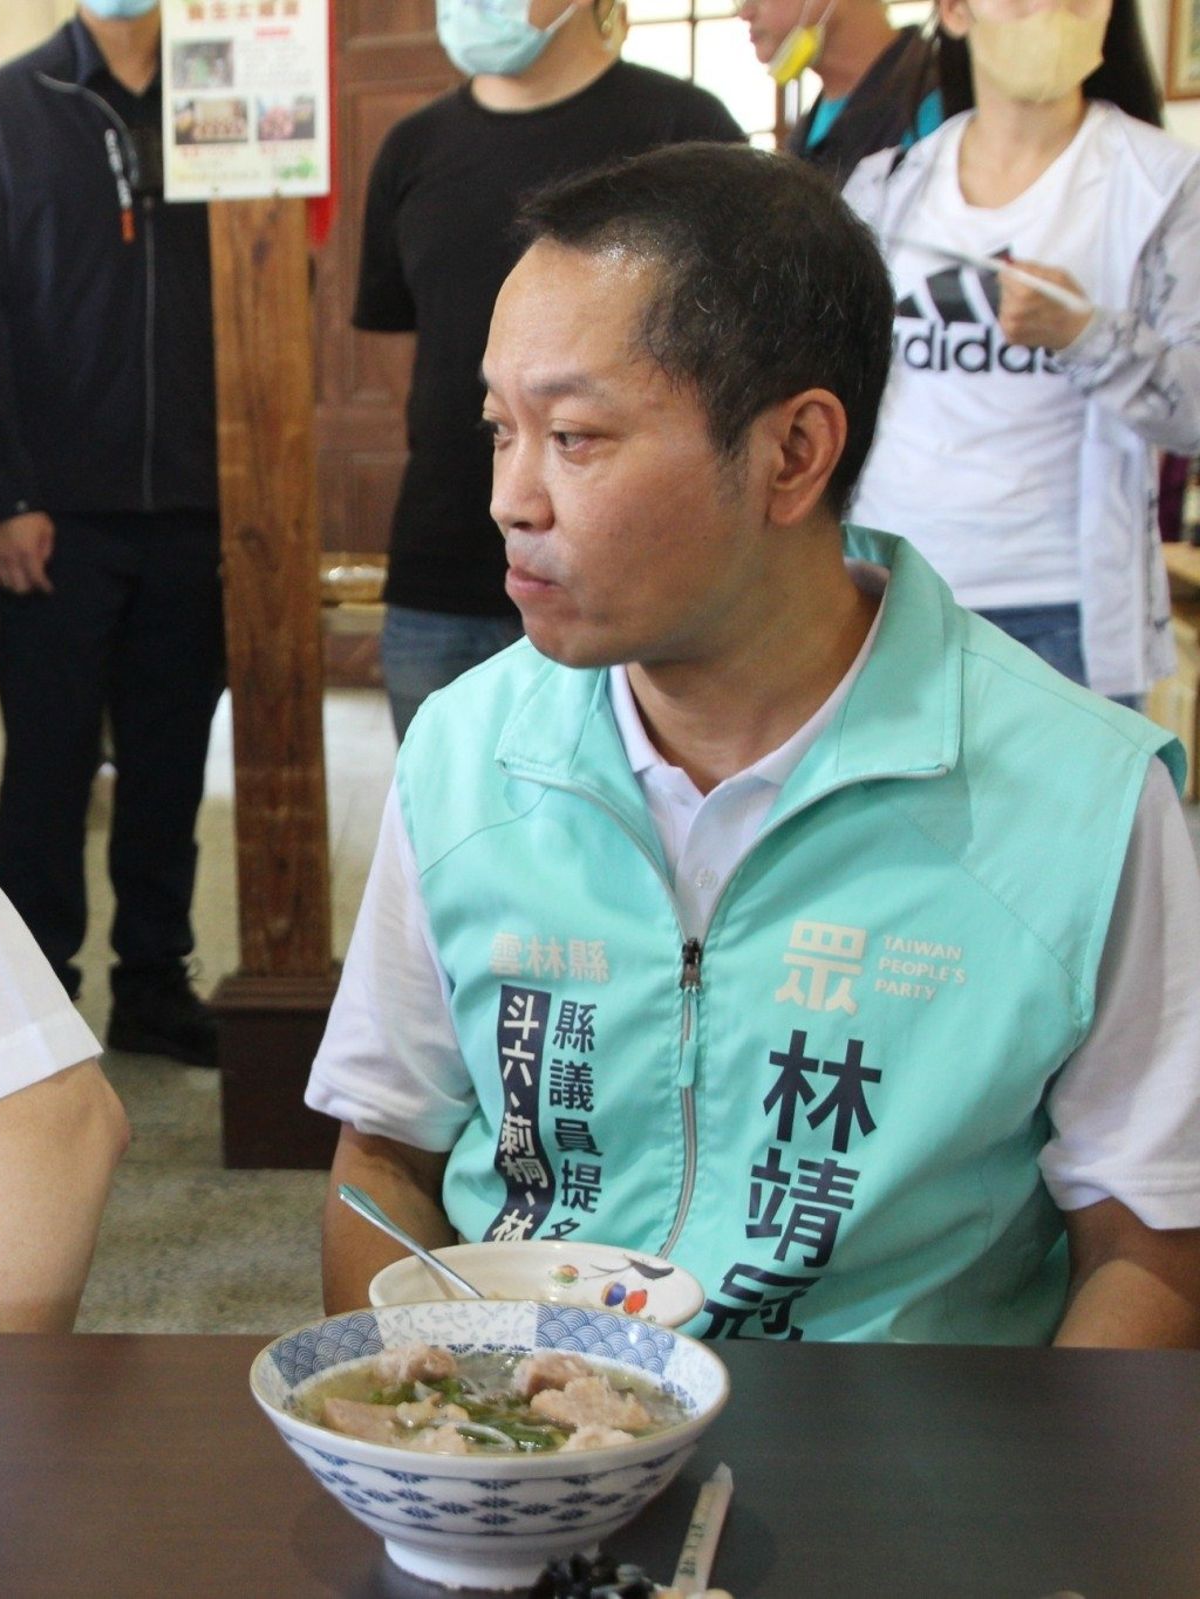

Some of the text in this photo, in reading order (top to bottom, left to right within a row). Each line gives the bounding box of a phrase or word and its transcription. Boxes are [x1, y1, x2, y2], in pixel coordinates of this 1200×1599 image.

[892, 322, 1064, 374] dida
[490, 931, 611, 984] 雲林縣
[883, 934, 963, 960] TAIWAN
[874, 978, 937, 1002] PARTY
[878, 957, 966, 984] PEOPLE'S
[700, 1029, 882, 1340] 林靖冠
